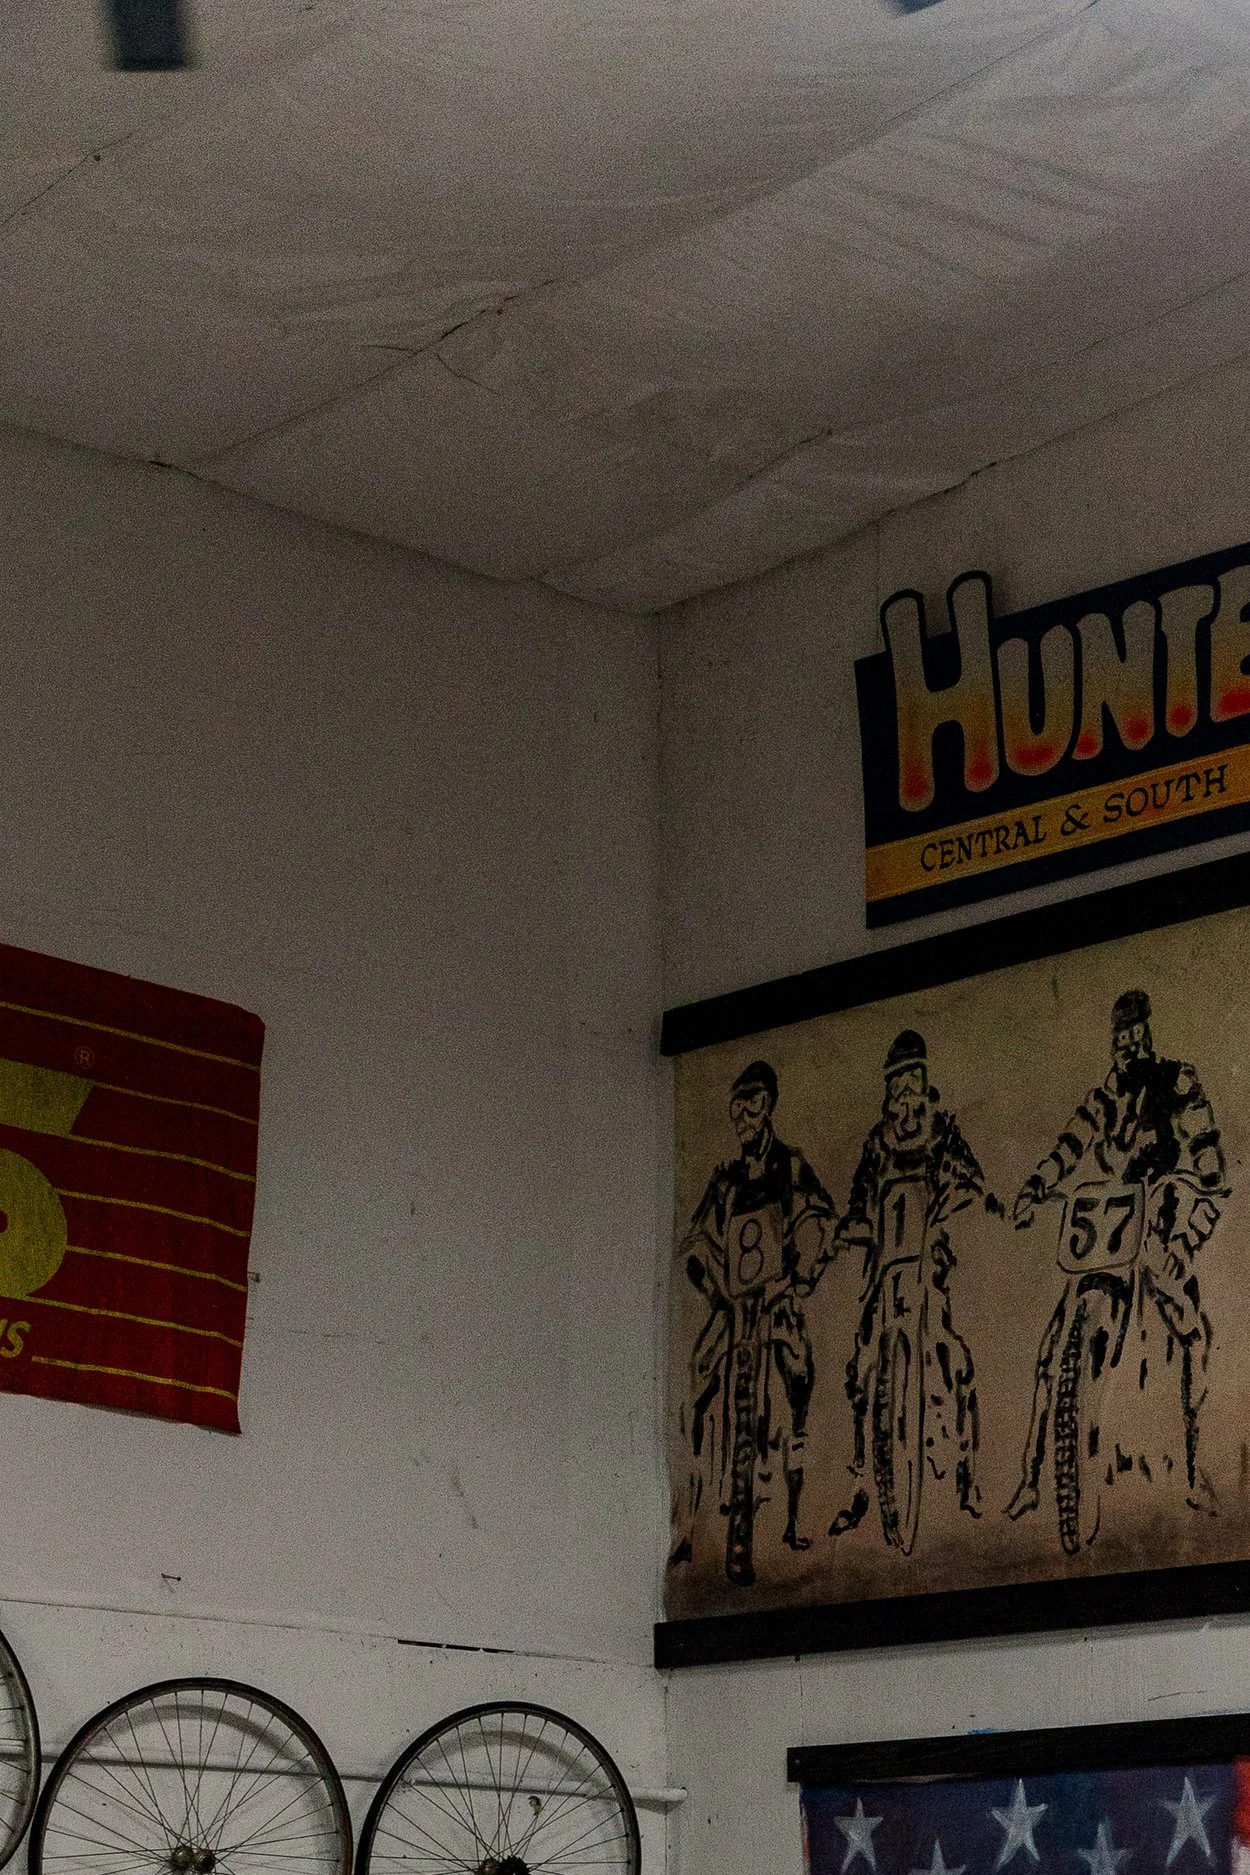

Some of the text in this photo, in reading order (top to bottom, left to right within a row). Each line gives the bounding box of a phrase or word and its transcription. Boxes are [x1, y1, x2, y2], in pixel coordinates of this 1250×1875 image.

[919, 816, 1047, 873] CENTRAL
[1059, 803, 1091, 836] &
[1102, 764, 1229, 825] SOUTH
[738, 1217, 765, 1286] 8
[894, 1192, 907, 1249] 1
[1069, 1192, 1136, 1261] 57
